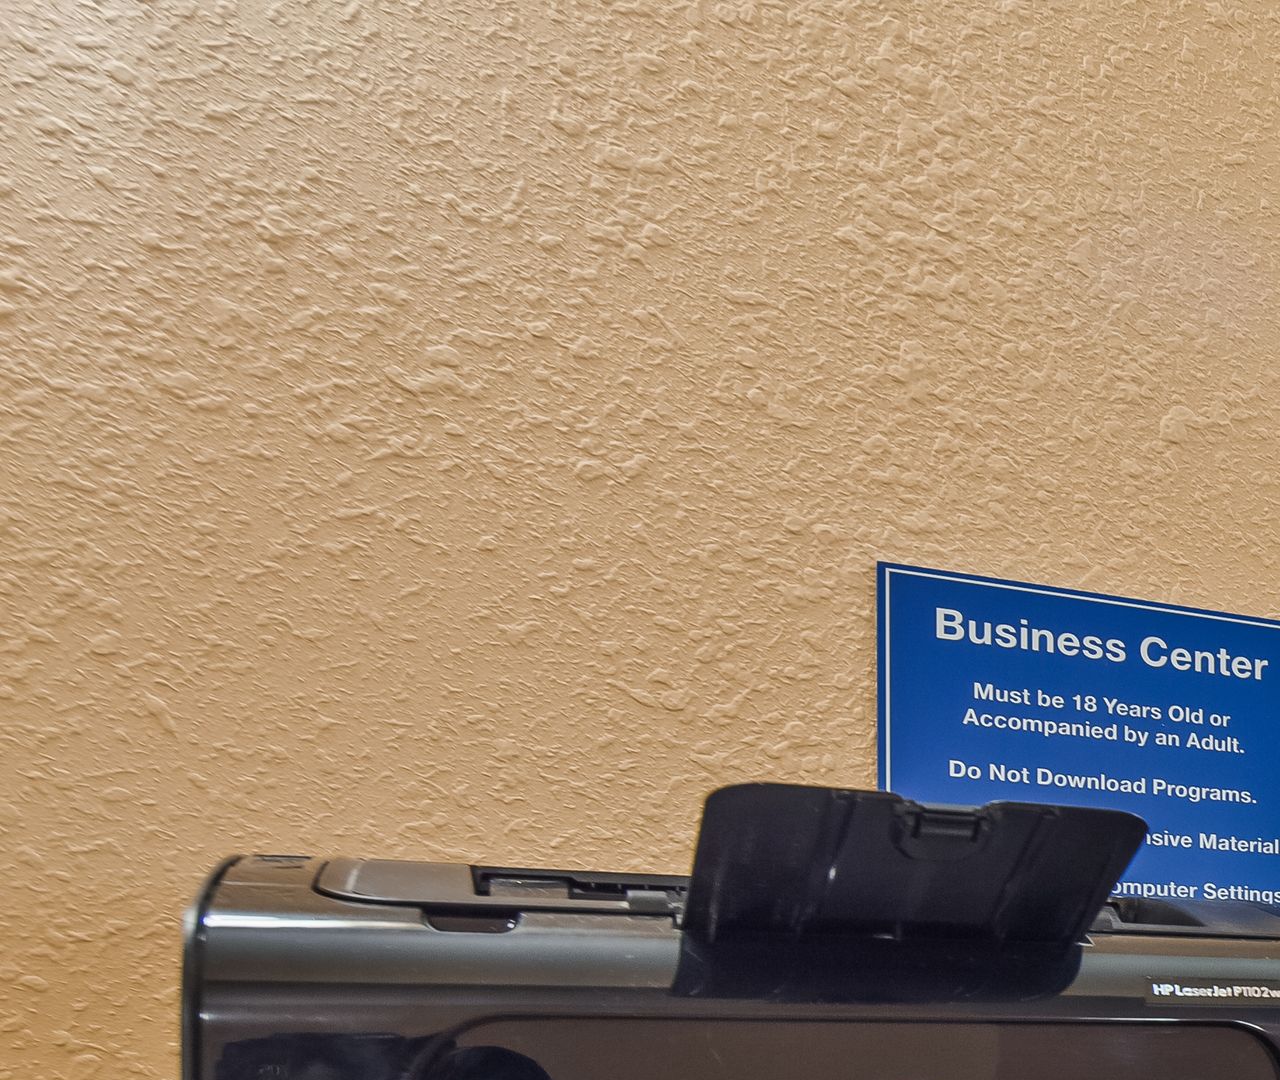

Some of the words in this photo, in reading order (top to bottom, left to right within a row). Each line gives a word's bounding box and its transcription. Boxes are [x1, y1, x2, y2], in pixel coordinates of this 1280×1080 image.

[935, 607, 1127, 662] Business
[1140, 636, 1270, 681] Center
[973, 682, 1031, 706] Must
[1037, 690, 1065, 709] be
[1072, 694, 1098, 713] 18
[1103, 697, 1163, 721] Years
[1168, 705, 1205, 725] Old
[1209, 714, 1231, 728] or
[962, 708, 1118, 741] Accompanied
[1124, 724, 1149, 747] by
[1155, 732, 1180, 747] an
[1186, 732, 1245, 754] Adult.
[949, 759, 982, 782] Do
[988, 763, 1031, 785] Not
[1036, 767, 1147, 795] Download
[1152, 778, 1258, 804] Programs.
[1152, 983, 1175, 997] HP
[1174, 984, 1234, 998] LaserJet
